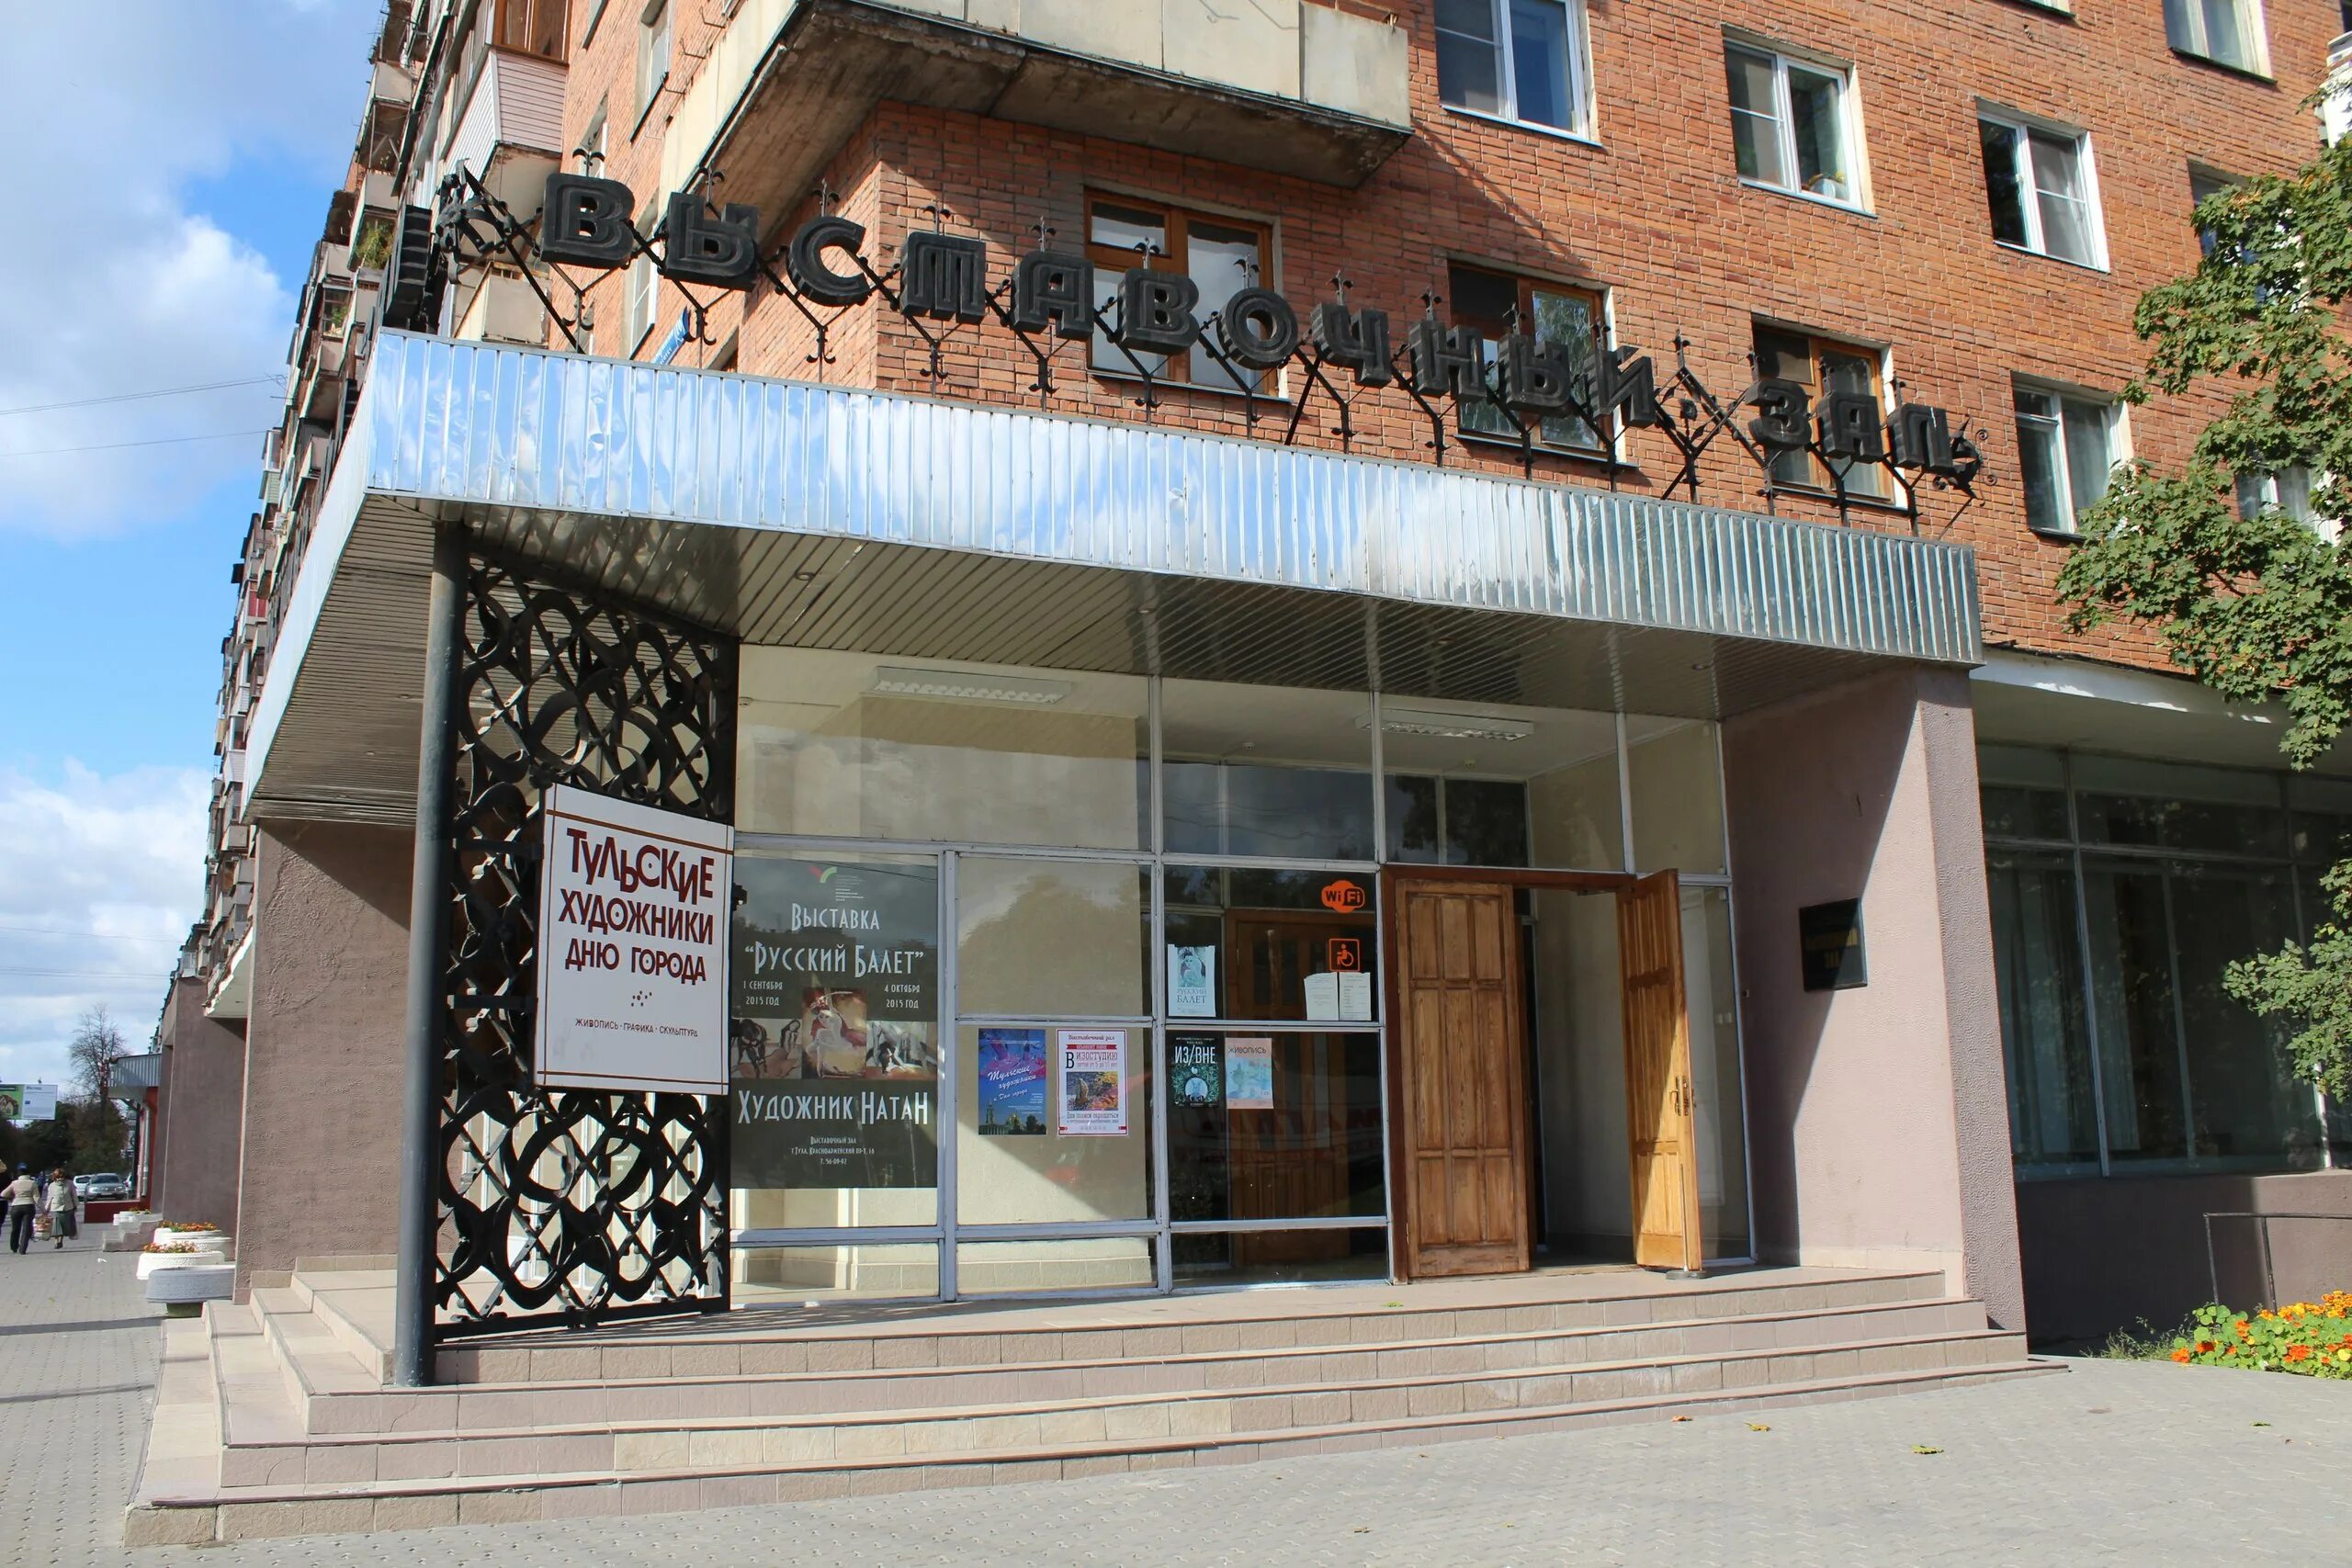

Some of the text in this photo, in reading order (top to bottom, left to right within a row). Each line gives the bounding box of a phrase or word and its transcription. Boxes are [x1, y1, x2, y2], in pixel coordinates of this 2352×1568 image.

[540, 172, 1953, 474] ВЫСТАВОЧНЫЙ ЗАЛ
[566, 828, 715, 906] ТУЛЬСКИЕ
[558, 887, 713, 946] ХУДОЖНИКИ
[564, 937, 707, 986] ДНЮ ГОРОДА
[749, 980, 783, 990] СЕНТЯБРЯ
[890, 984, 921, 993] ОКТЯБРЯ
[745, 996, 764, 1006] 2015
[886, 998, 904, 1009] 2015
[1177, 995, 1206, 1004] БАЛЕТ
[575, 1017, 698, 1038] ЖИВОПИСЬ ГРАФИКА СКУЛЬПТУРА
[1065, 1052, 1118, 1069] В ИЗОСТУДИЮ
[1174, 1045, 1216, 1066] ИЗ/ВНЕ
